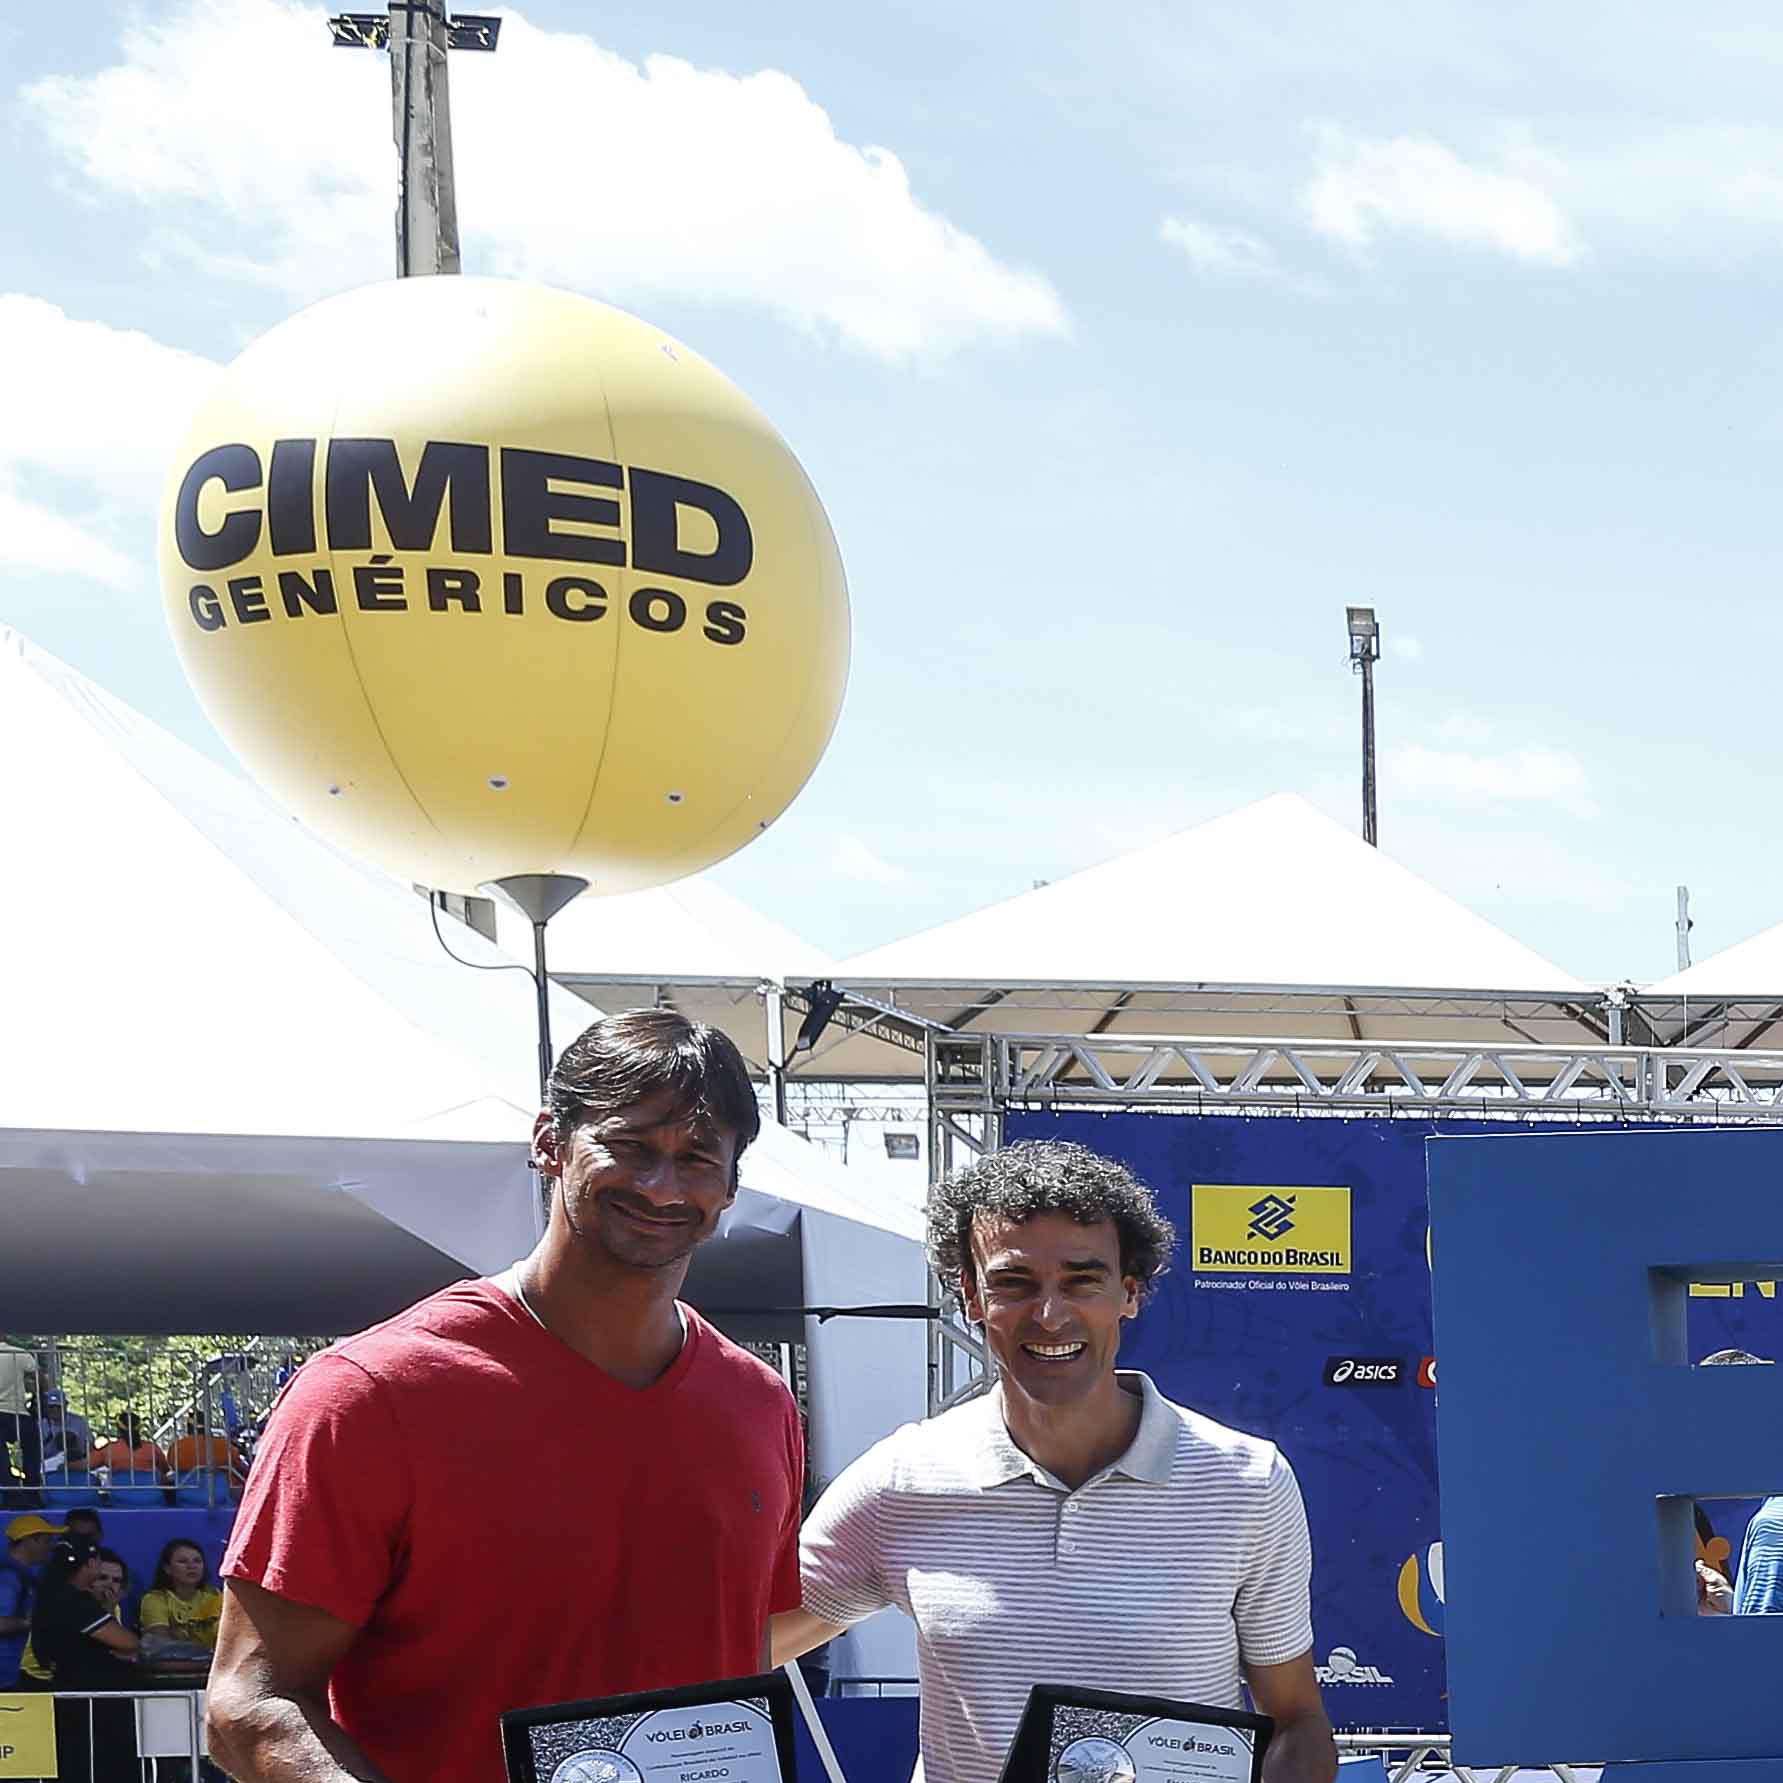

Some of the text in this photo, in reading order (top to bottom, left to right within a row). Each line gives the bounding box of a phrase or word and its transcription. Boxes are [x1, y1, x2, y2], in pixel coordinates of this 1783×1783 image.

[175, 437, 754, 587] CIMED
[188, 555, 748, 647] GENÉRICOS
[1199, 1248, 1344, 1267] BANCO DO BRASIL
[1194, 1279, 1246, 1290] Patrocinador
[1248, 1280, 1274, 1290] Oficial
[1275, 1280, 1287, 1291] do
[1311, 1281, 1350, 1292] Brasileiro
[1353, 1365, 1398, 1381] asics
[705, 1720, 753, 1737] BRASIL
[1196, 1741, 1237, 1757] BRASIL
[679, 1767, 730, 1783] RICARDO
